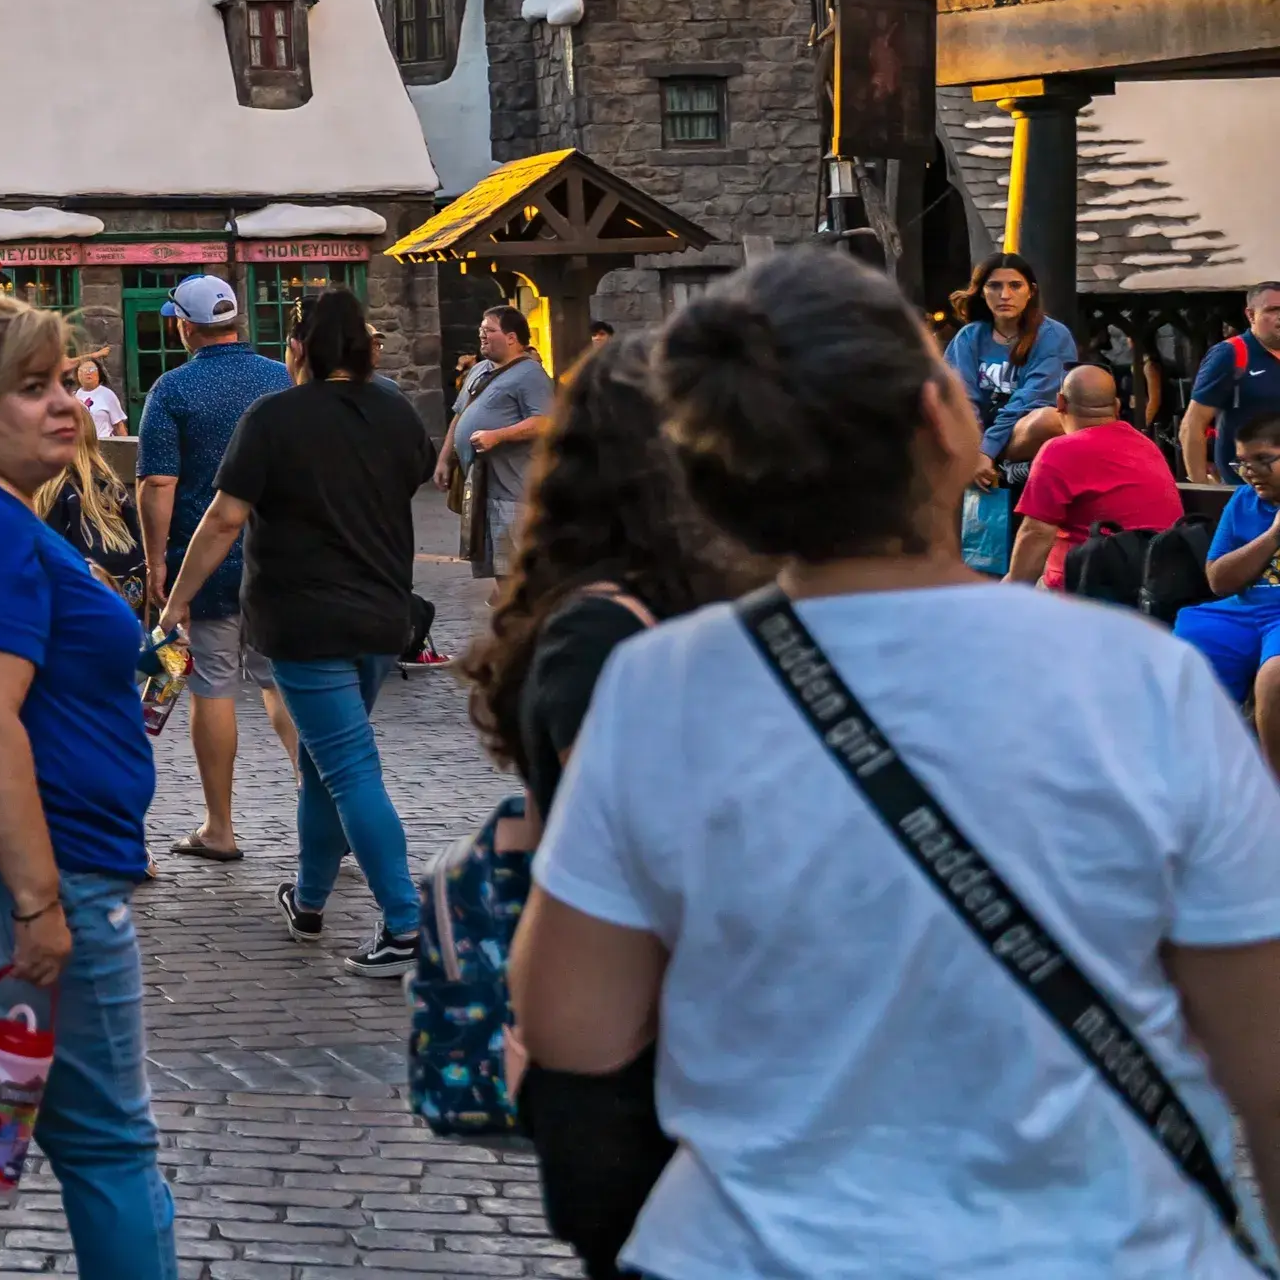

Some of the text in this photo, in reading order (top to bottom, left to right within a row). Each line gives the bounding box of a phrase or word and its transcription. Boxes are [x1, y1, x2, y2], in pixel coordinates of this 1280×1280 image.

[265, 243, 360, 258] HONEYDUKES
[757, 612, 897, 777] madden girl
[899, 806, 1064, 984] madden girl
